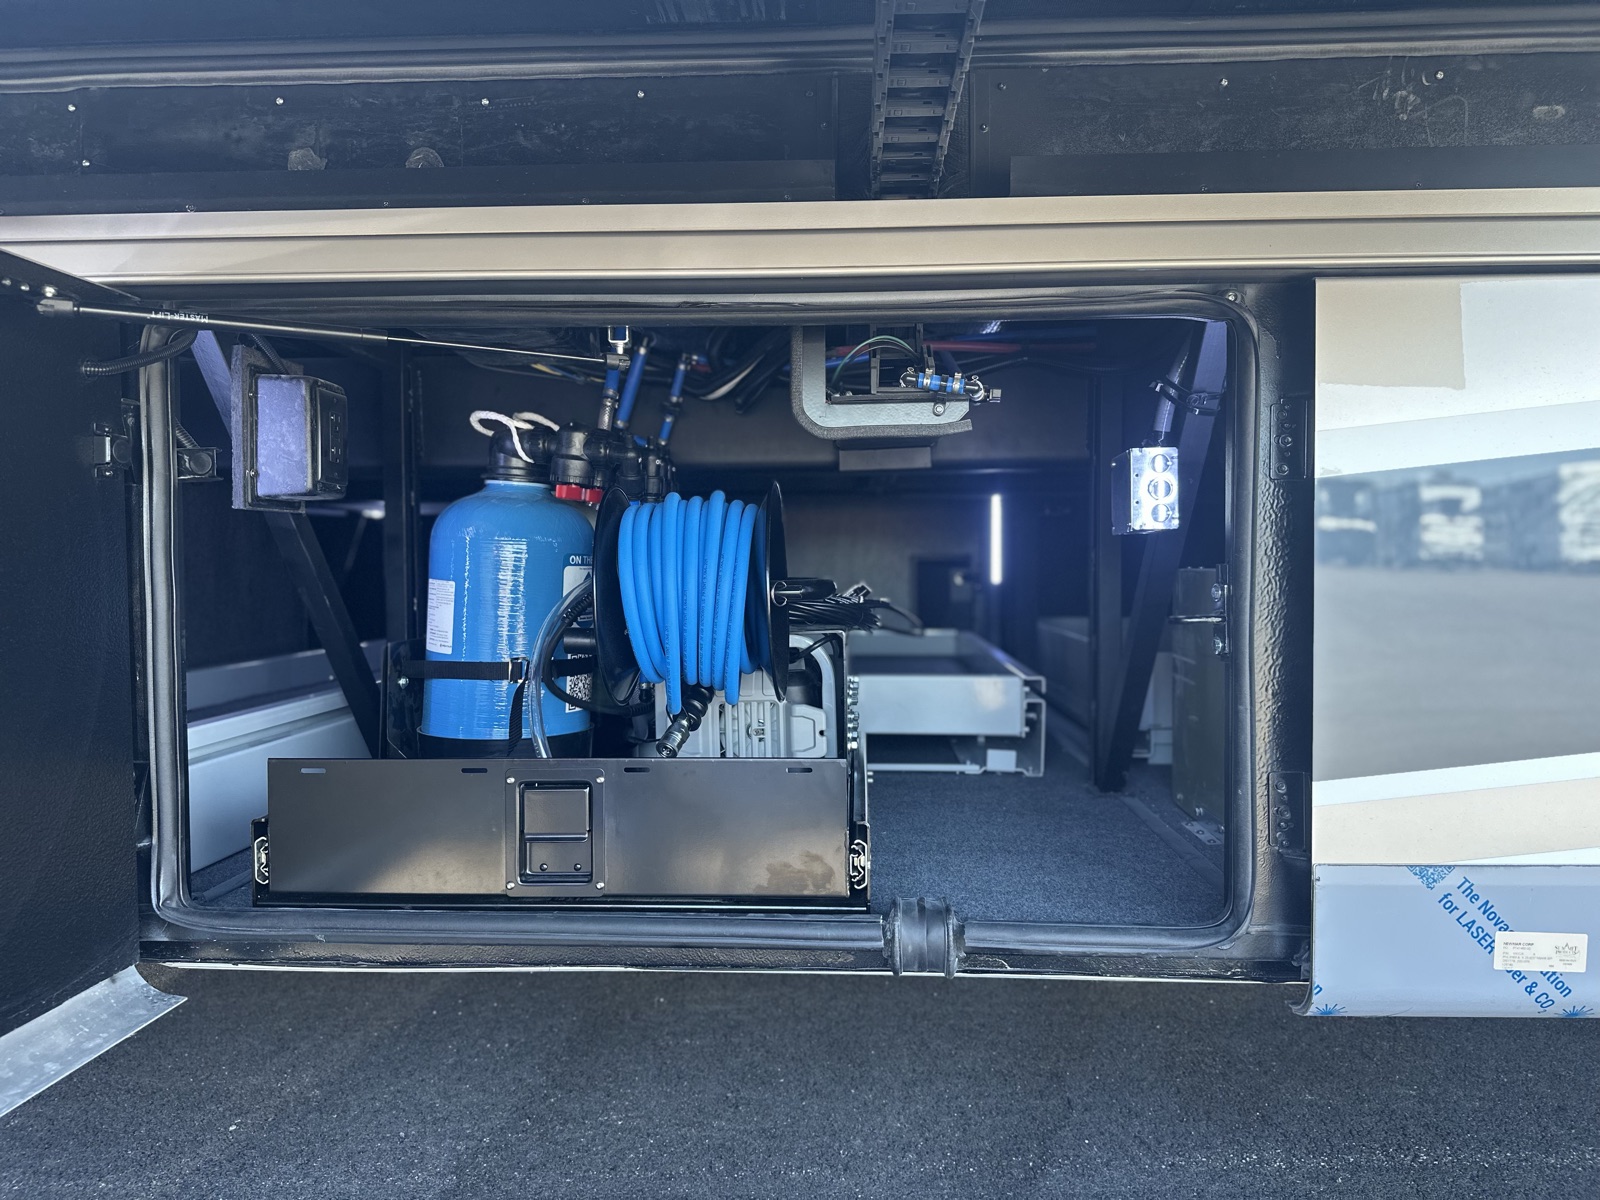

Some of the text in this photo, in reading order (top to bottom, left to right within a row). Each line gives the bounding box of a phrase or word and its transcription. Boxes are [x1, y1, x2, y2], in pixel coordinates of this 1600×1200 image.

[569, 555, 582, 565] ON
[1456, 876, 1480, 904] The
[1477, 899, 1515, 932] Nova
[1438, 892, 1460, 914] for
[1455, 911, 1496, 955] LASER
[1524, 981, 1538, 996] &
